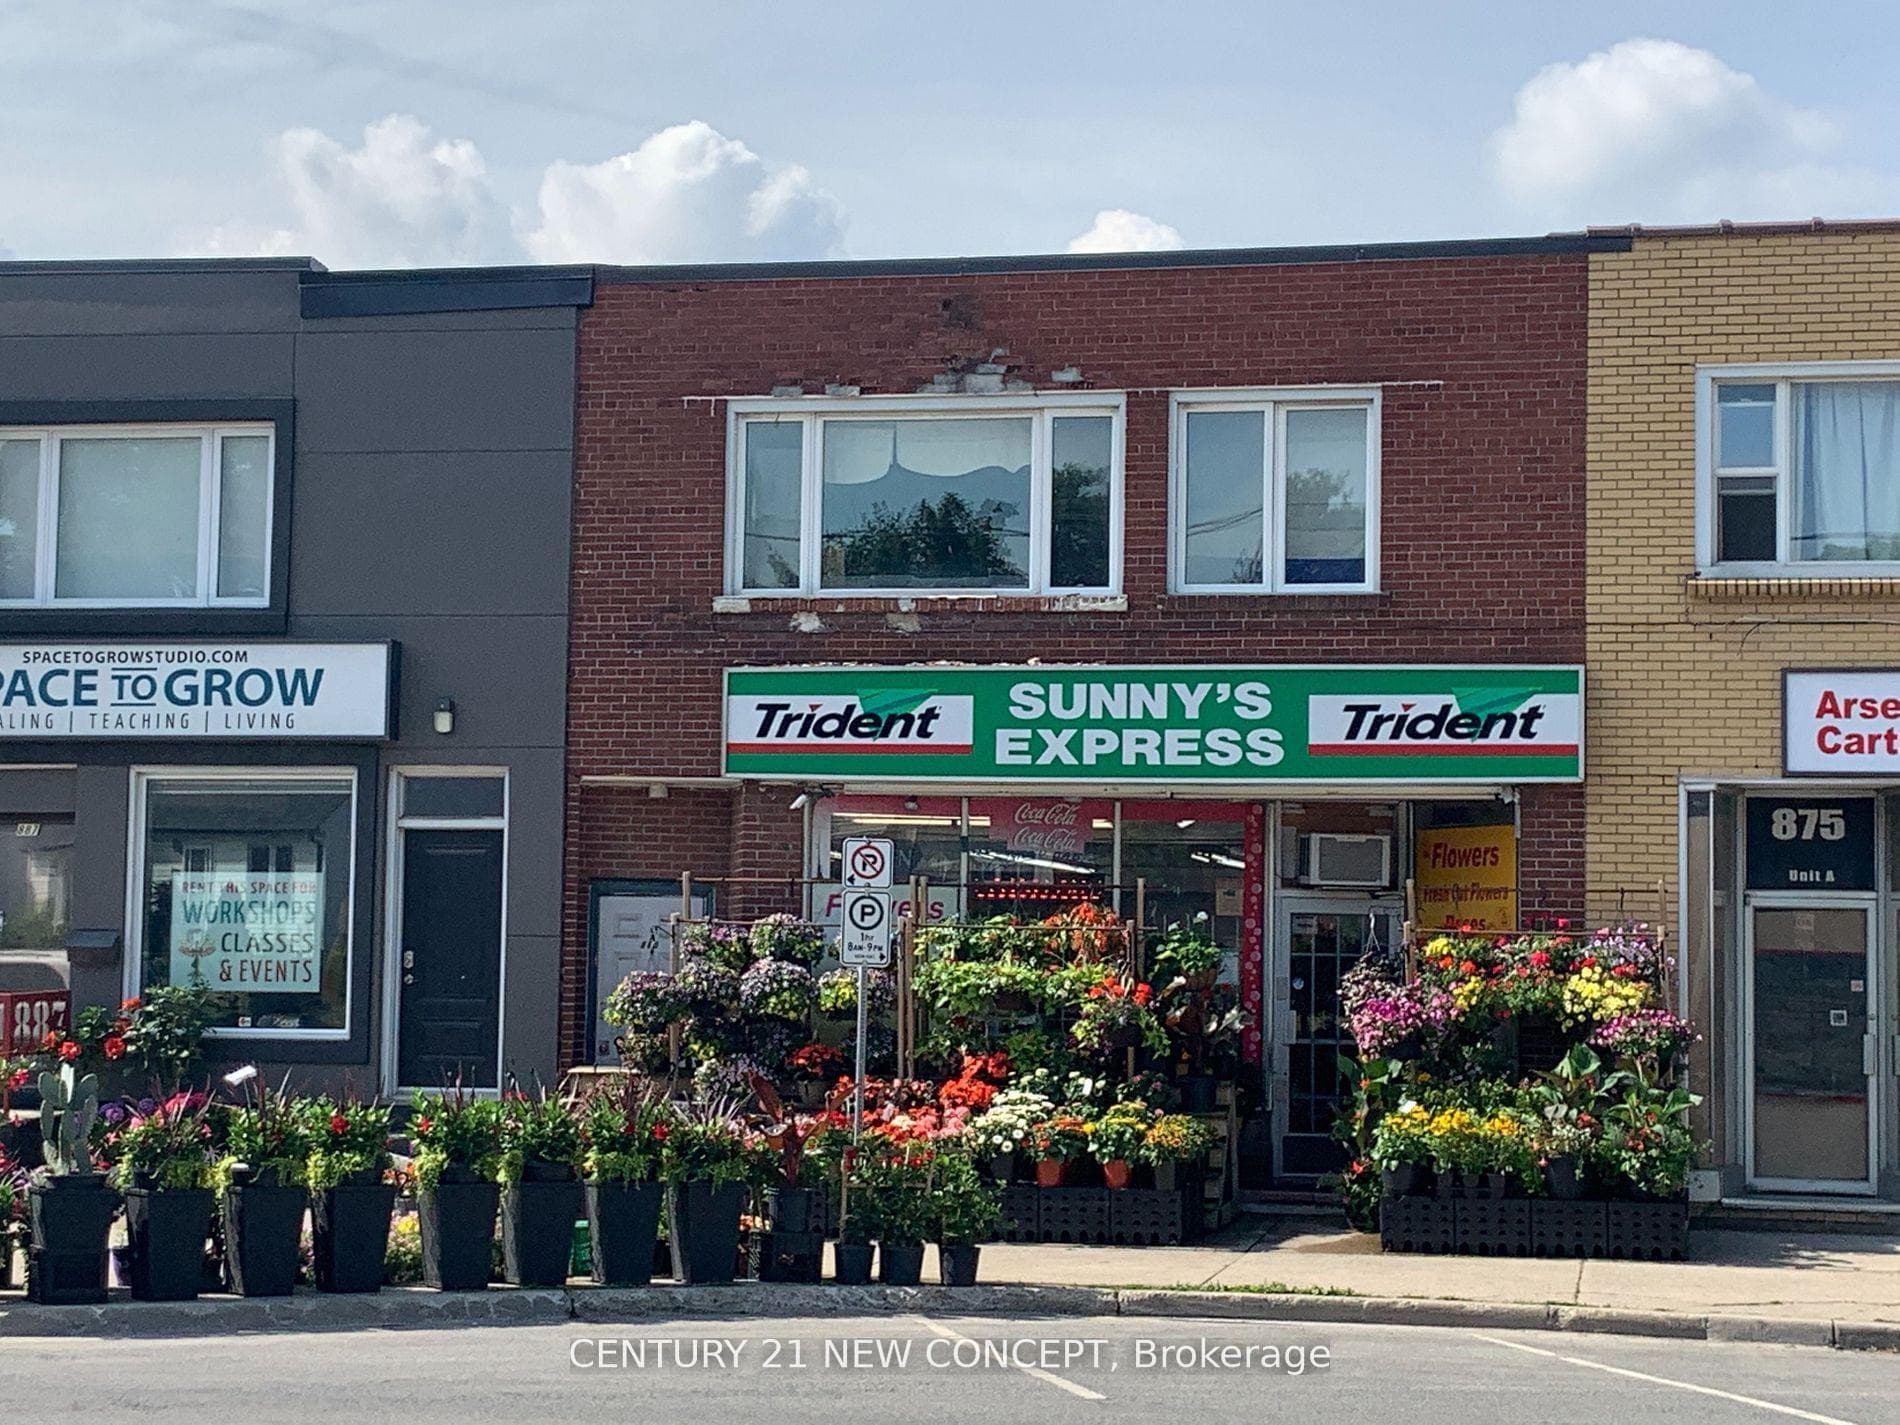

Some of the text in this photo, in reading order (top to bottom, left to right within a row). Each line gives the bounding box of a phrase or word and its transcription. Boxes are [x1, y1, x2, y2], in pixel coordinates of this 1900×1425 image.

[22, 650, 248, 664] SPACETOGROWSTUDIO.COM
[0, 667, 325, 707] ACE TO GROW
[1009, 681, 1272, 720] SUNNY'S
[89, 712, 191, 730] TEACHING
[224, 712, 296, 730] LIVING
[755, 702, 941, 740] Trident
[1342, 702, 1544, 741] Trident
[995, 727, 1285, 766] EXPRESS
[1771, 807, 1846, 840] 875
[1431, 842, 1499, 869] Flowers
[220, 881, 246, 894] HIS
[250, 881, 289, 894] SPACE
[1788, 869, 1835, 882] Unit A
[182, 900, 316, 924] WORKSHOPS
[221, 932, 314, 953] CLASSES
[219, 958, 312, 983] & EVENTS
